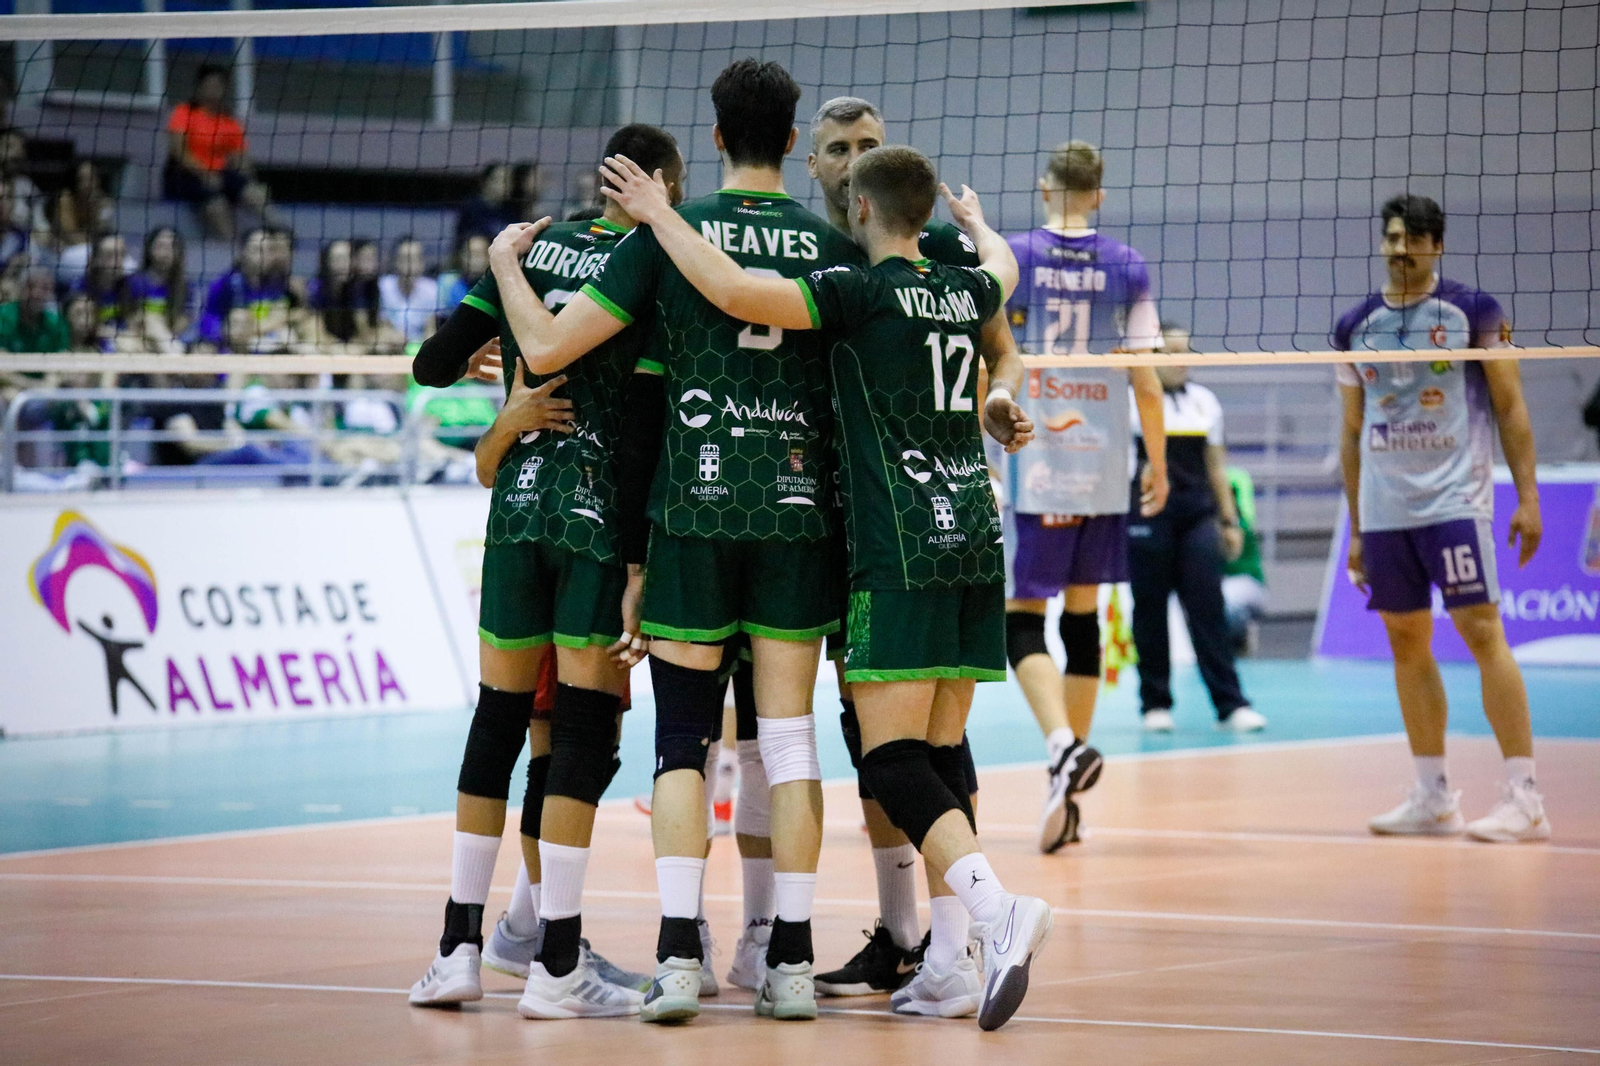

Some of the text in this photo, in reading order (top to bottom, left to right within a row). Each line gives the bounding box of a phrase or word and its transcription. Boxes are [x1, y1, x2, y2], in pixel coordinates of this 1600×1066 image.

[700, 220, 819, 260] NEAVES
[520, 240, 611, 280] ODRÍG
[924, 332, 973, 412] 12
[720, 394, 809, 427] Andalucía
[505, 491, 539, 502] ALMERÍA
[690, 485, 729, 495] ALMERÍA
[776, 475, 817, 486] DIPUTACIÓN
[777, 484, 788, 492] DE
[927, 532, 966, 544] ALMERÍA
[1442, 544, 1478, 584] 16
[179, 582, 377, 628] COSTA DE
[165, 632, 407, 713] ALMERÍA
